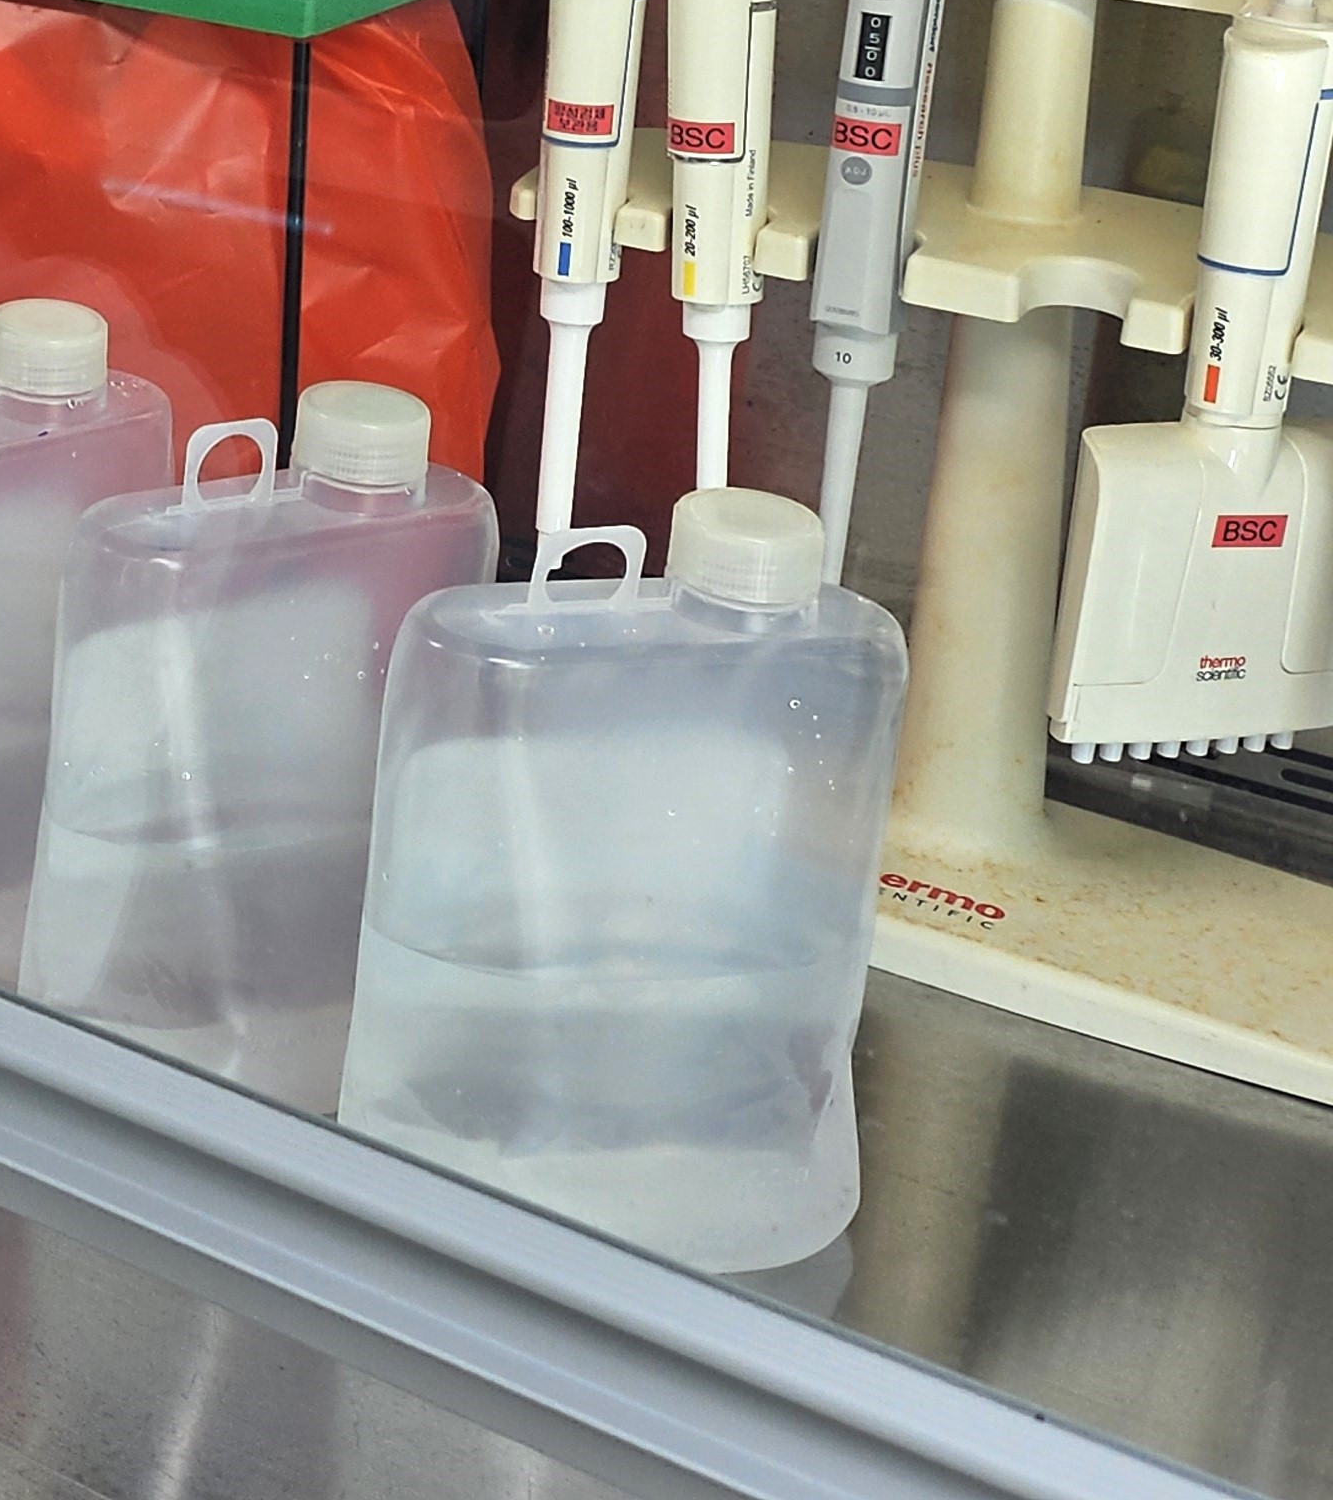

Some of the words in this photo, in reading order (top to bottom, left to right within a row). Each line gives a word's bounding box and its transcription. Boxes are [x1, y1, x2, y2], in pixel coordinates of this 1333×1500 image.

[670, 124, 726, 150] BSC
[835, 120, 893, 150] BSC
[746, 149, 756, 181] Finland
[562, 191, 576, 238] 100-1000
[745, 193, 754, 217] Made
[684, 218, 696, 257] 20-200
[1209, 321, 1226, 362] 30-300
[835, 351, 852, 364] 10
[1222, 520, 1278, 542] BSC
[1195, 667, 1247, 682] scientific
[1199, 655, 1247, 669] thermo
[878, 886, 995, 931] ENTIFIC
[879, 873, 1006, 920] ermo
